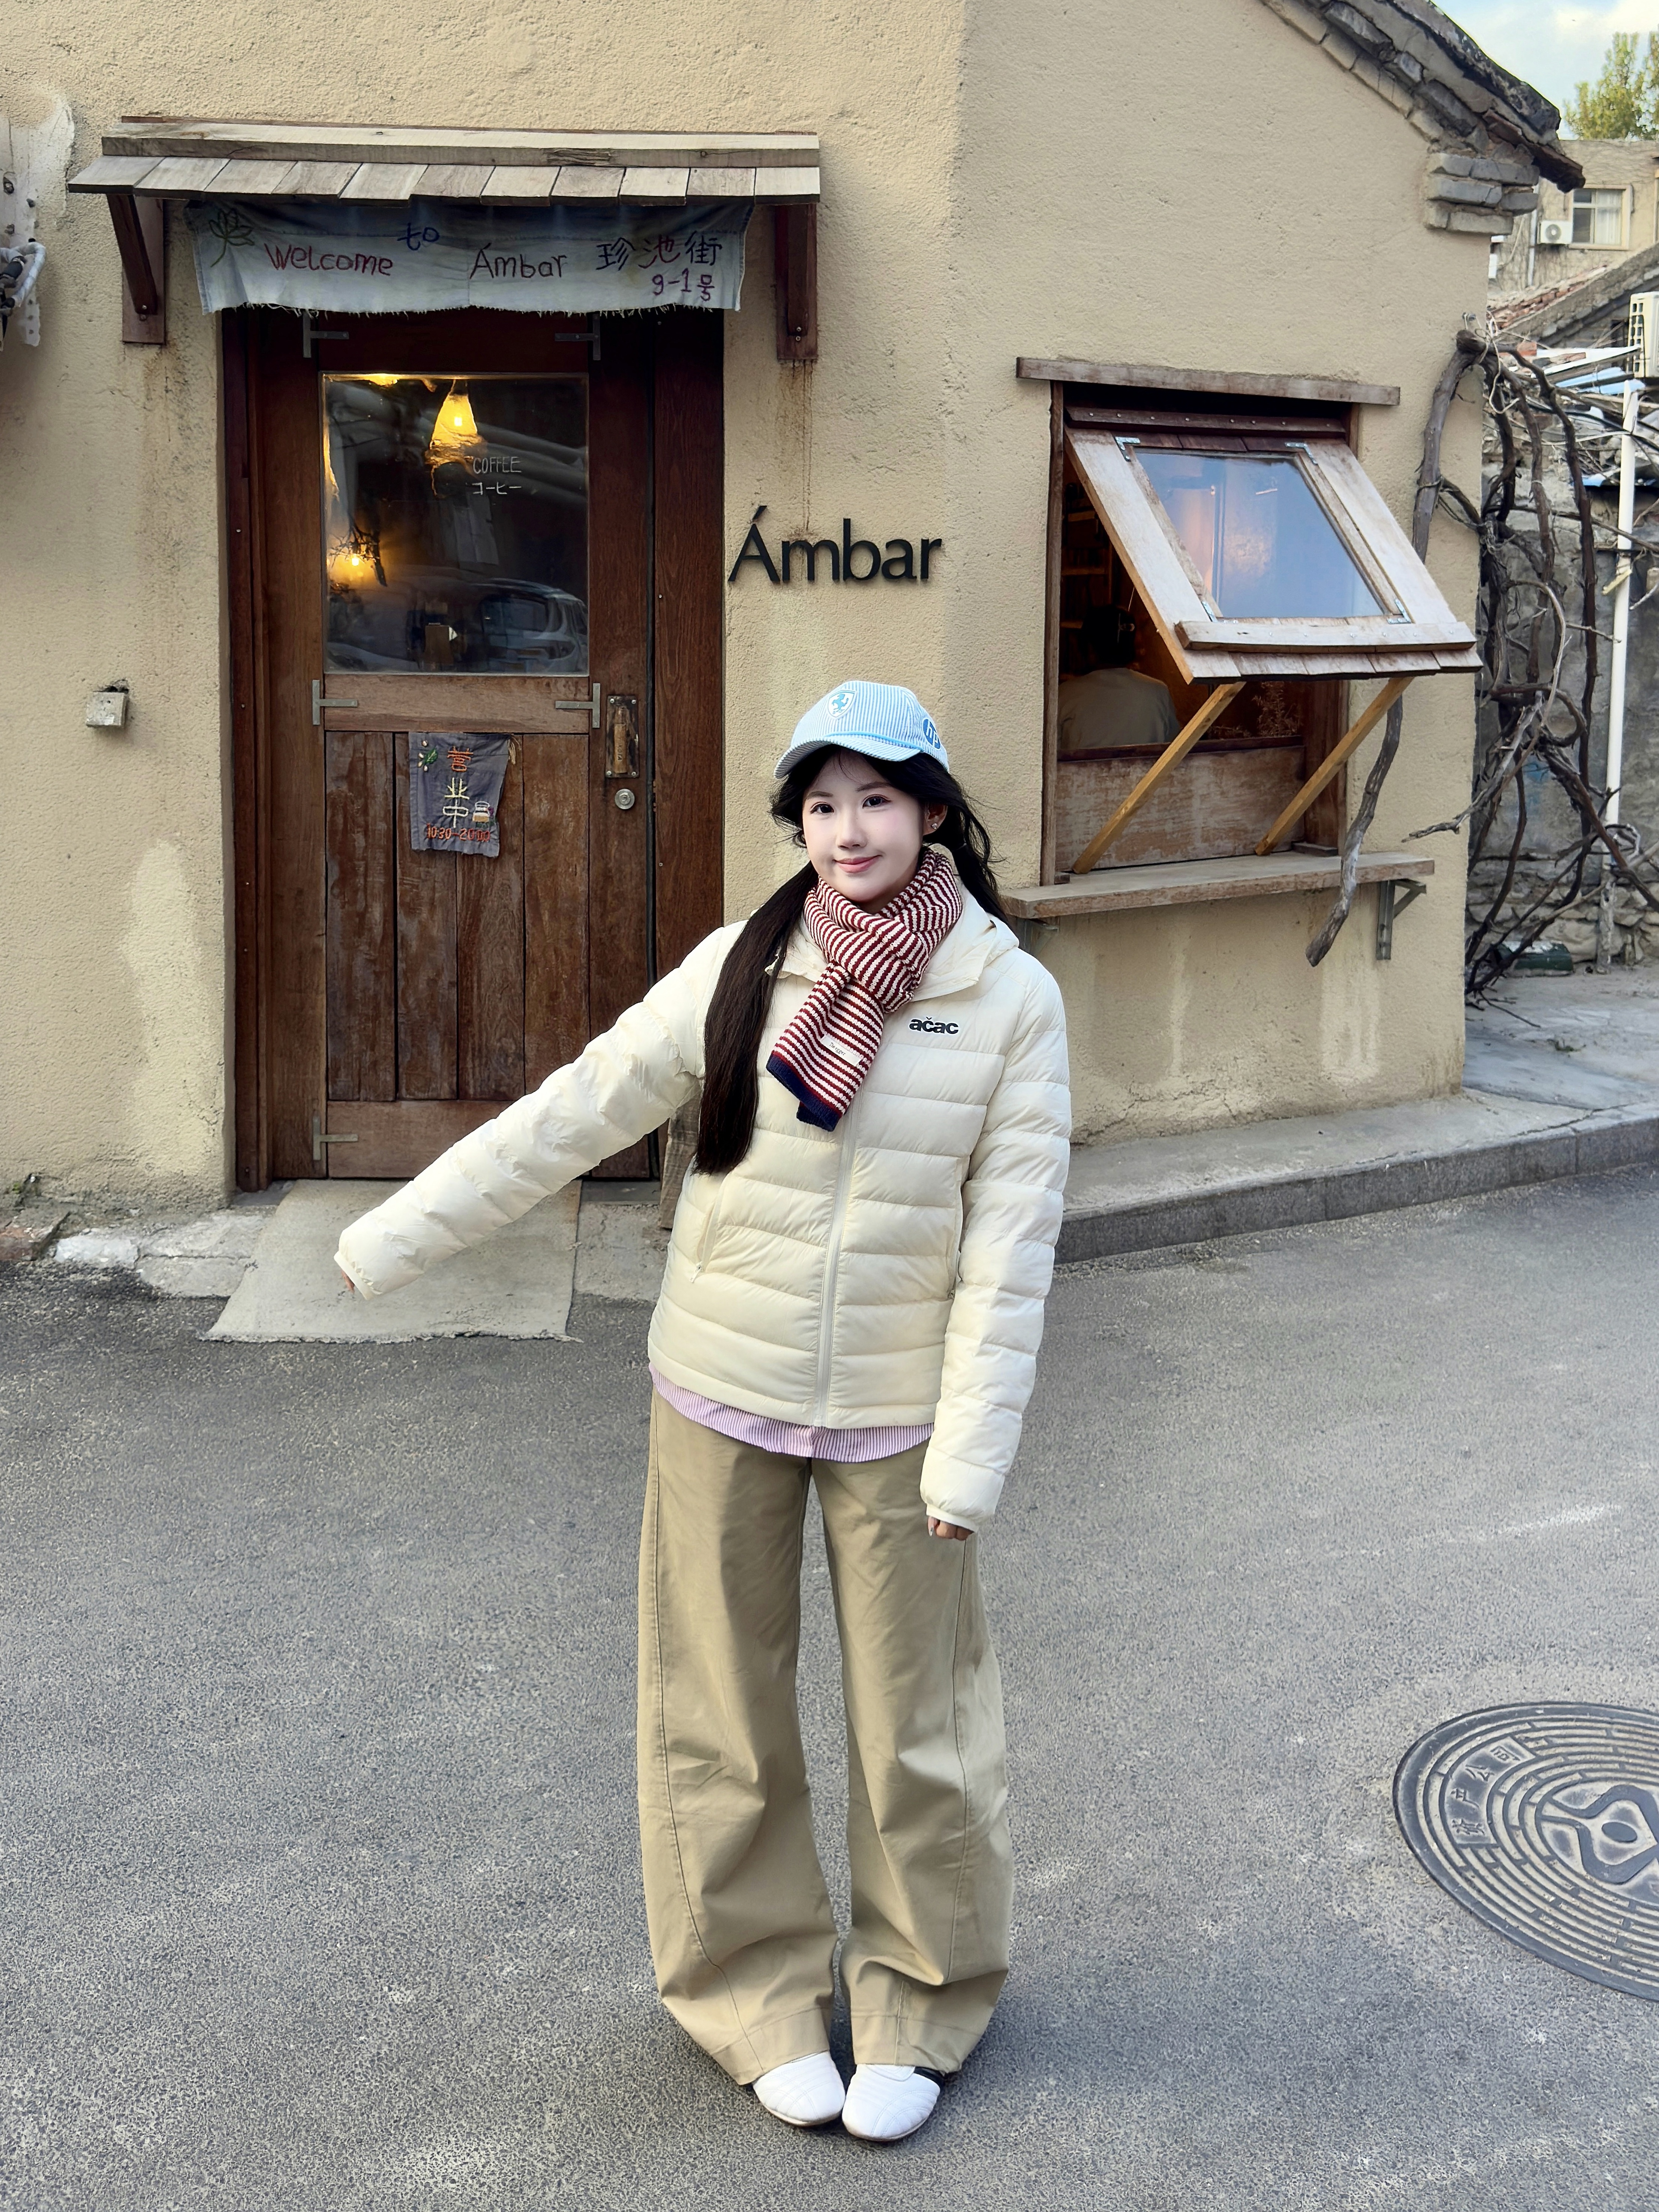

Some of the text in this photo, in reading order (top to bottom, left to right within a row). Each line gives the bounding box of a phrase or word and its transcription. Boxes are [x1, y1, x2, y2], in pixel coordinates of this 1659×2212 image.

[264, 223, 567, 279] Welcome to Ámbar
[596, 233, 722, 271] 珍池街
[472, 482, 522, 495] コーヒー
[473, 456, 522, 474] COFFEE
[728, 505, 942, 583] Ámbar
[925, 719, 939, 747] hp
[442, 746, 474, 828] 营业中
[1450, 1745, 1521, 1835] 资产公司
